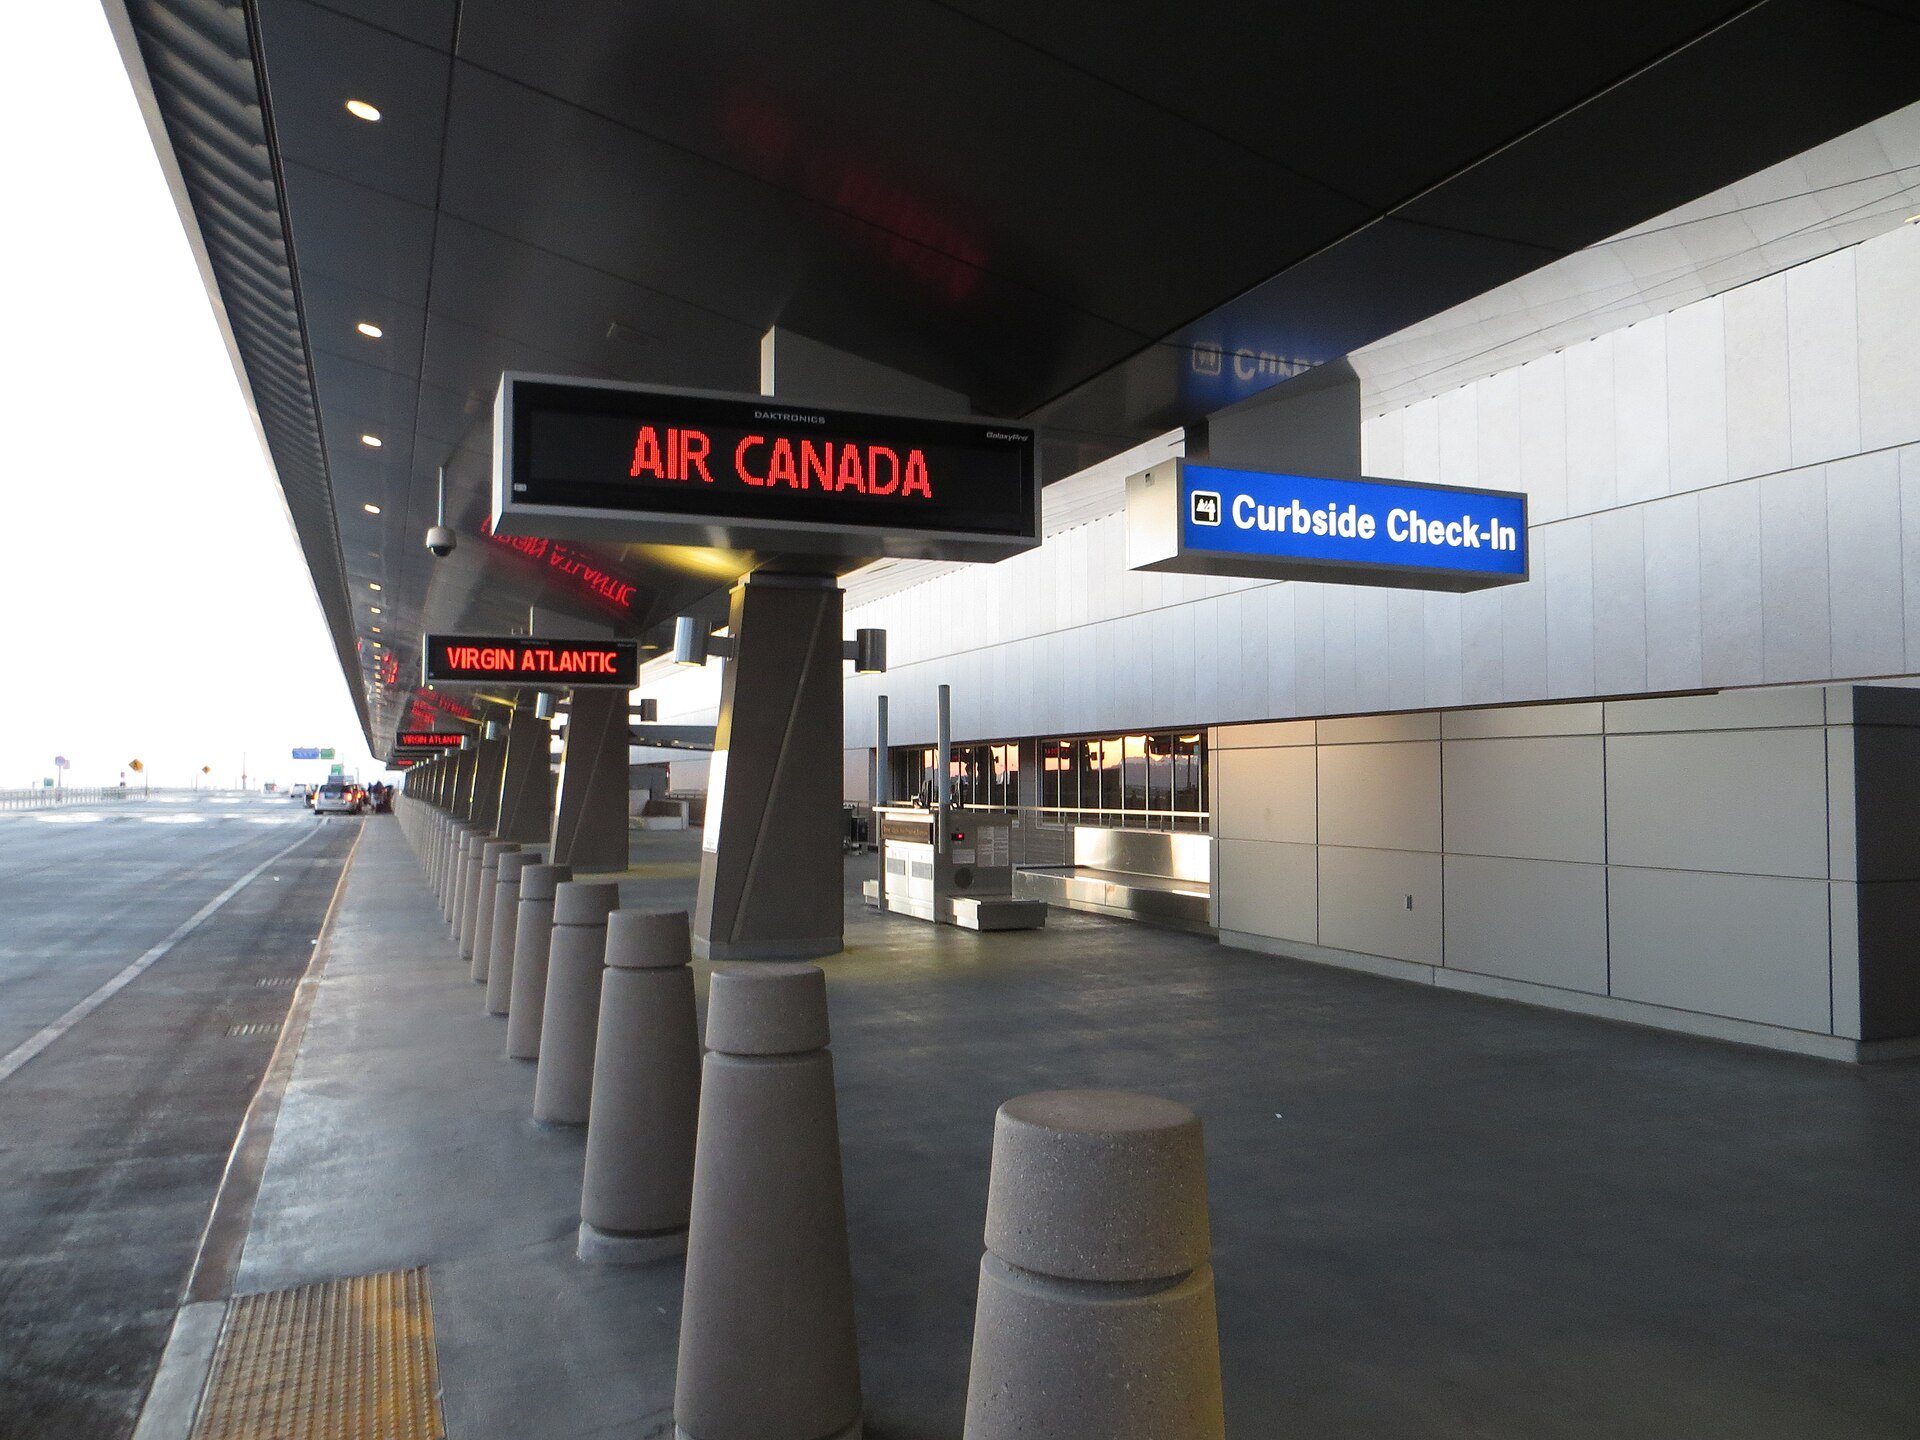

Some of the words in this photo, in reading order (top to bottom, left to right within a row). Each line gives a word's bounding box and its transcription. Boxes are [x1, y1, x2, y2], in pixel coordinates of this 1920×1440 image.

[754, 411, 826, 425] DAKTRONICS
[630, 426, 714, 483] AIR
[735, 435, 932, 499] CANADA
[1232, 494, 1376, 540] Curbside
[1386, 508, 1517, 551] Check-In
[446, 646, 515, 670] VIRGIN
[521, 649, 617, 674] ATLANTIC
